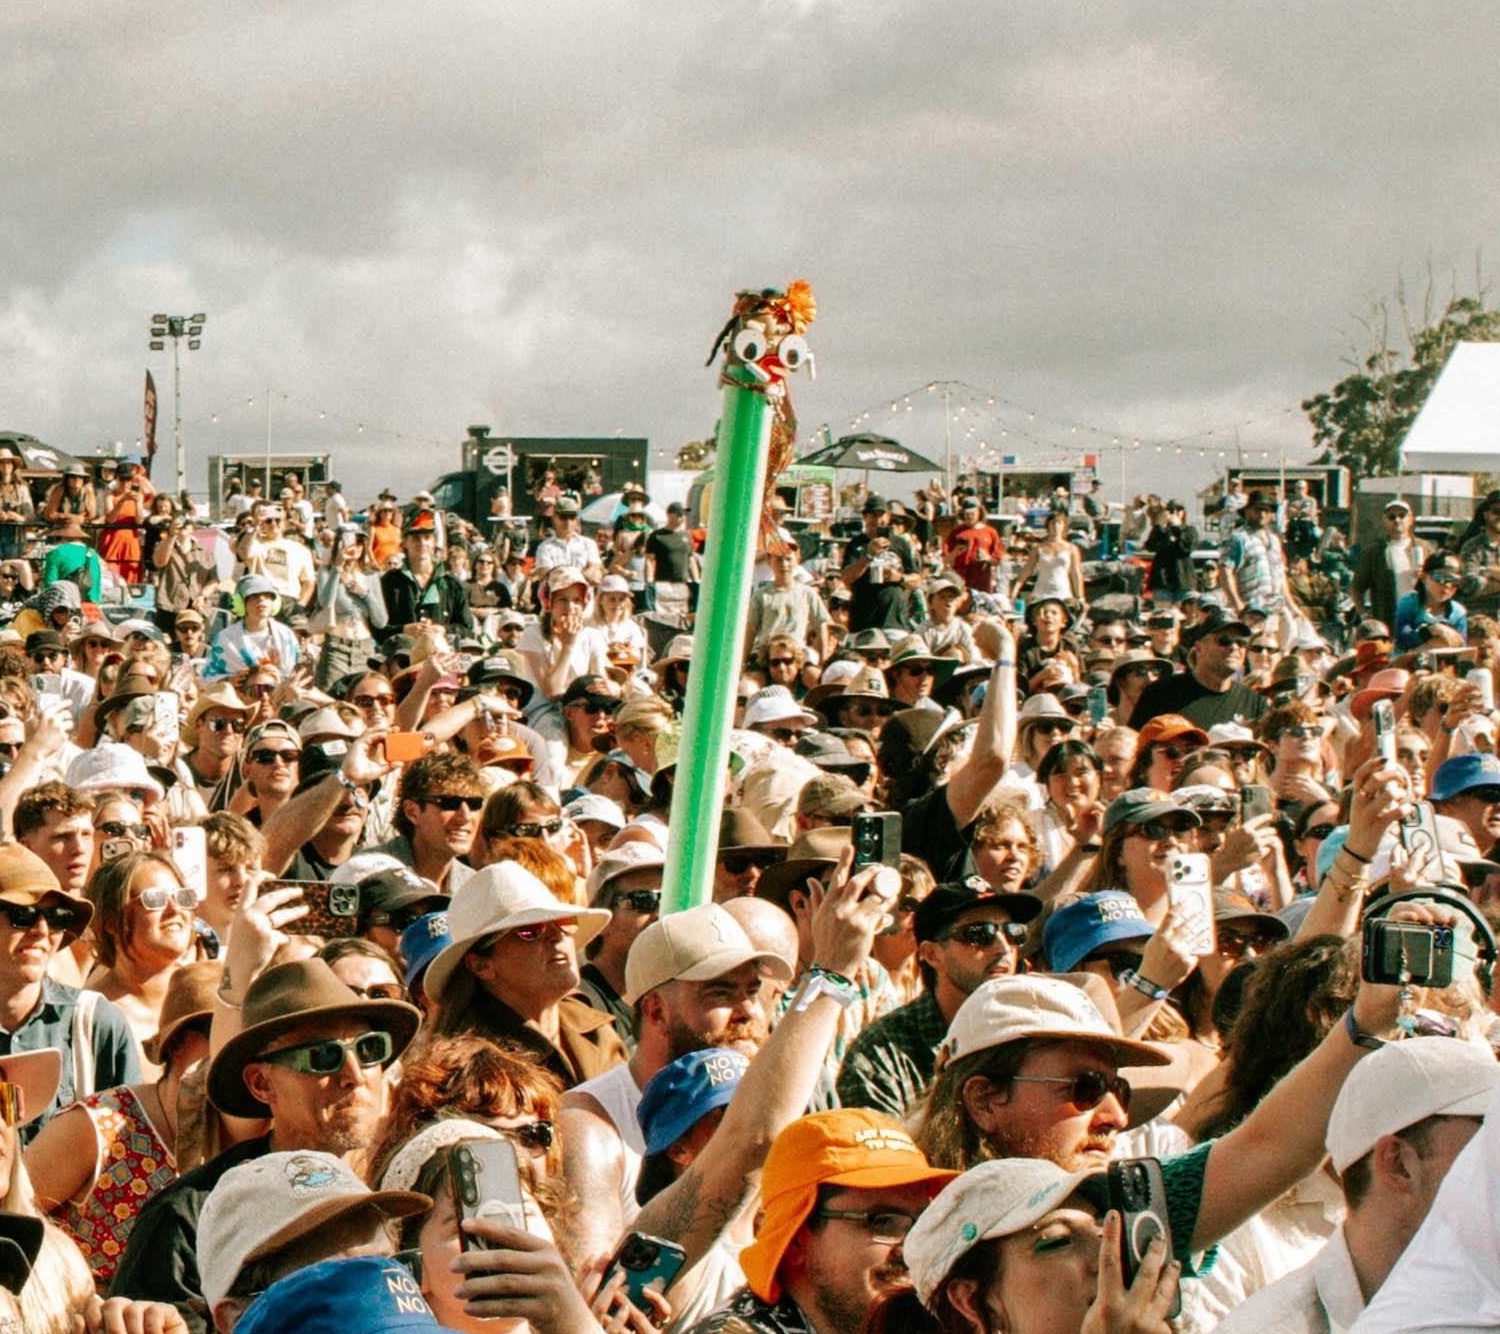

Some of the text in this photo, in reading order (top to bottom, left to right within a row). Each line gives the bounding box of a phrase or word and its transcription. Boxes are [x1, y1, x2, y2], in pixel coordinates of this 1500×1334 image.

[705, 1056, 730, 1073] NO
[711, 1068, 735, 1087] NO
[386, 1275, 416, 1294] NO
[396, 1295, 426, 1314] NO
